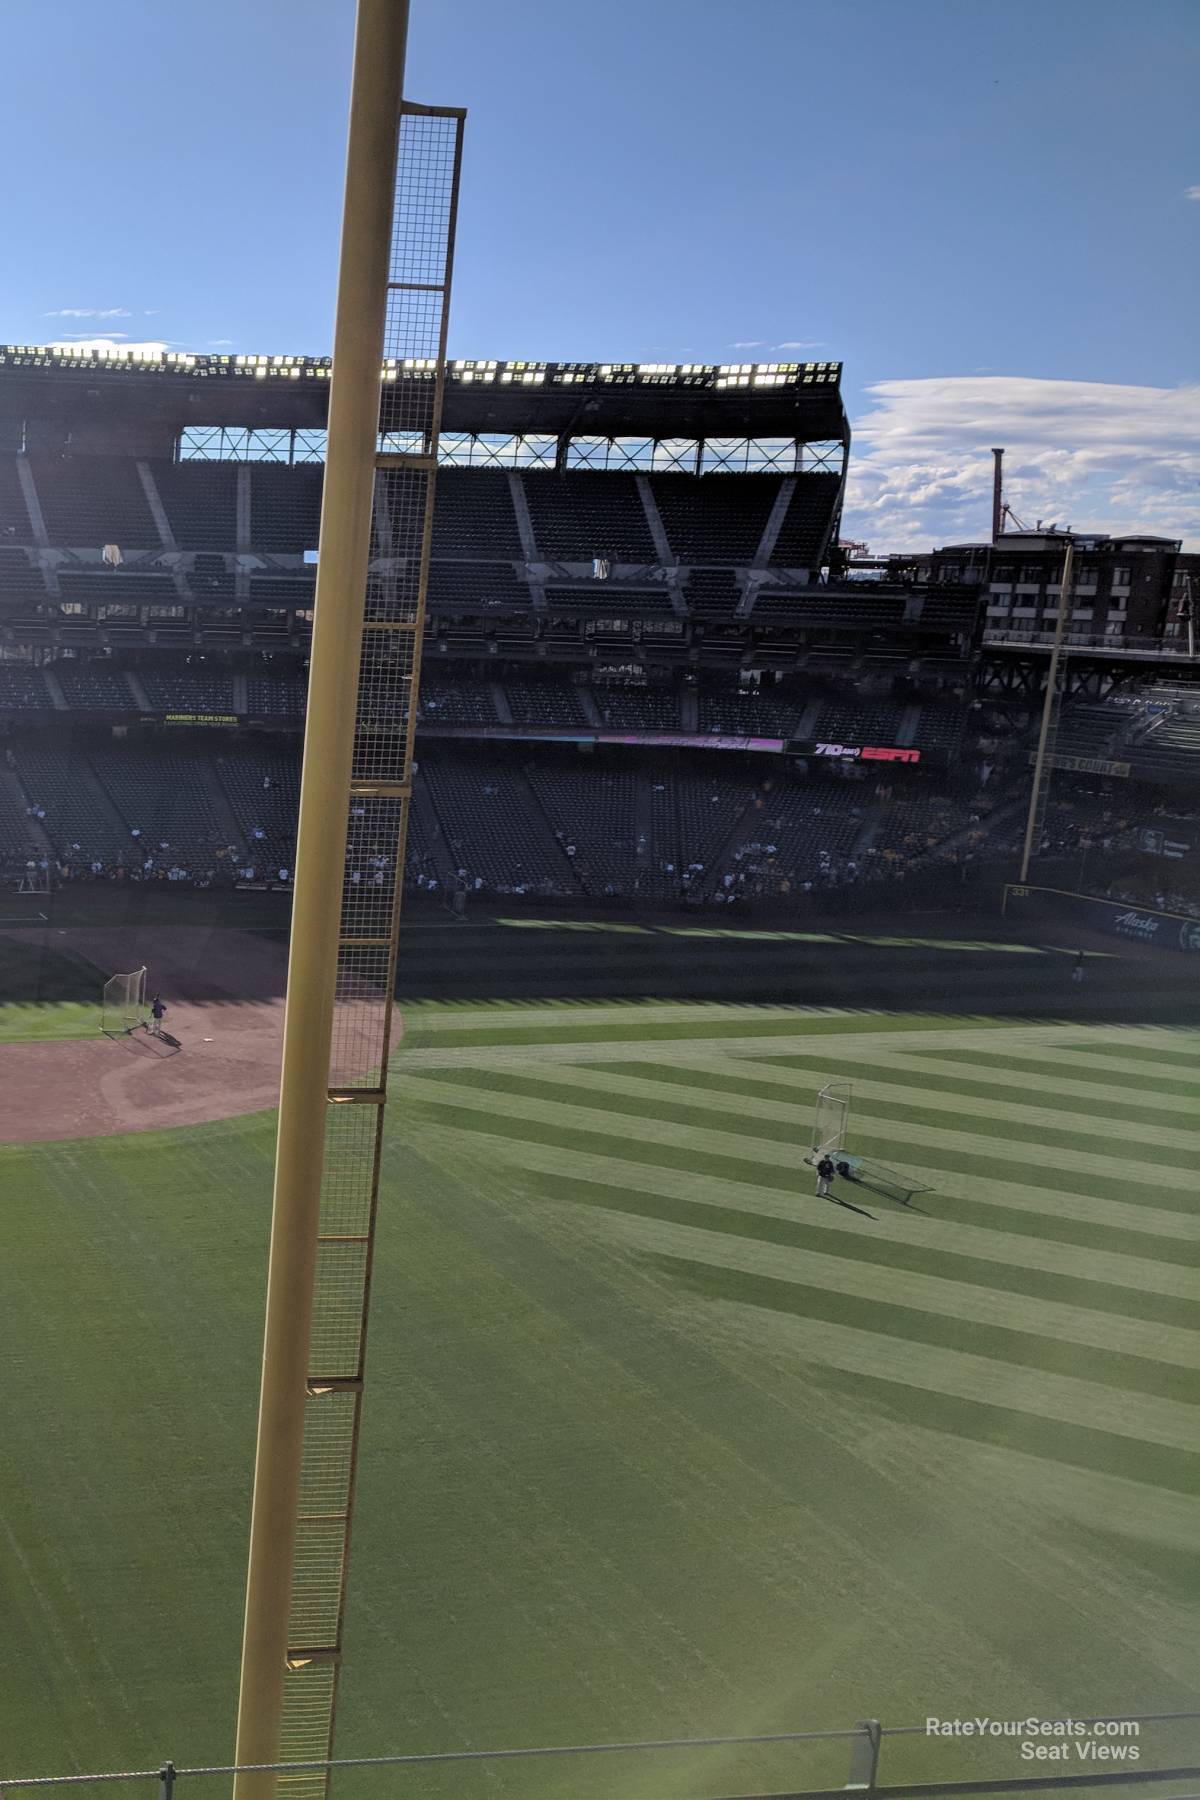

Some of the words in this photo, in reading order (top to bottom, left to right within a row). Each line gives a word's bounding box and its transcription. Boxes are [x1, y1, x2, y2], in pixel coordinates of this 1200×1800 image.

[814, 743, 843, 756] 710
[861, 746, 921, 763] ESPN
[1114, 911, 1159, 931] Alaska
